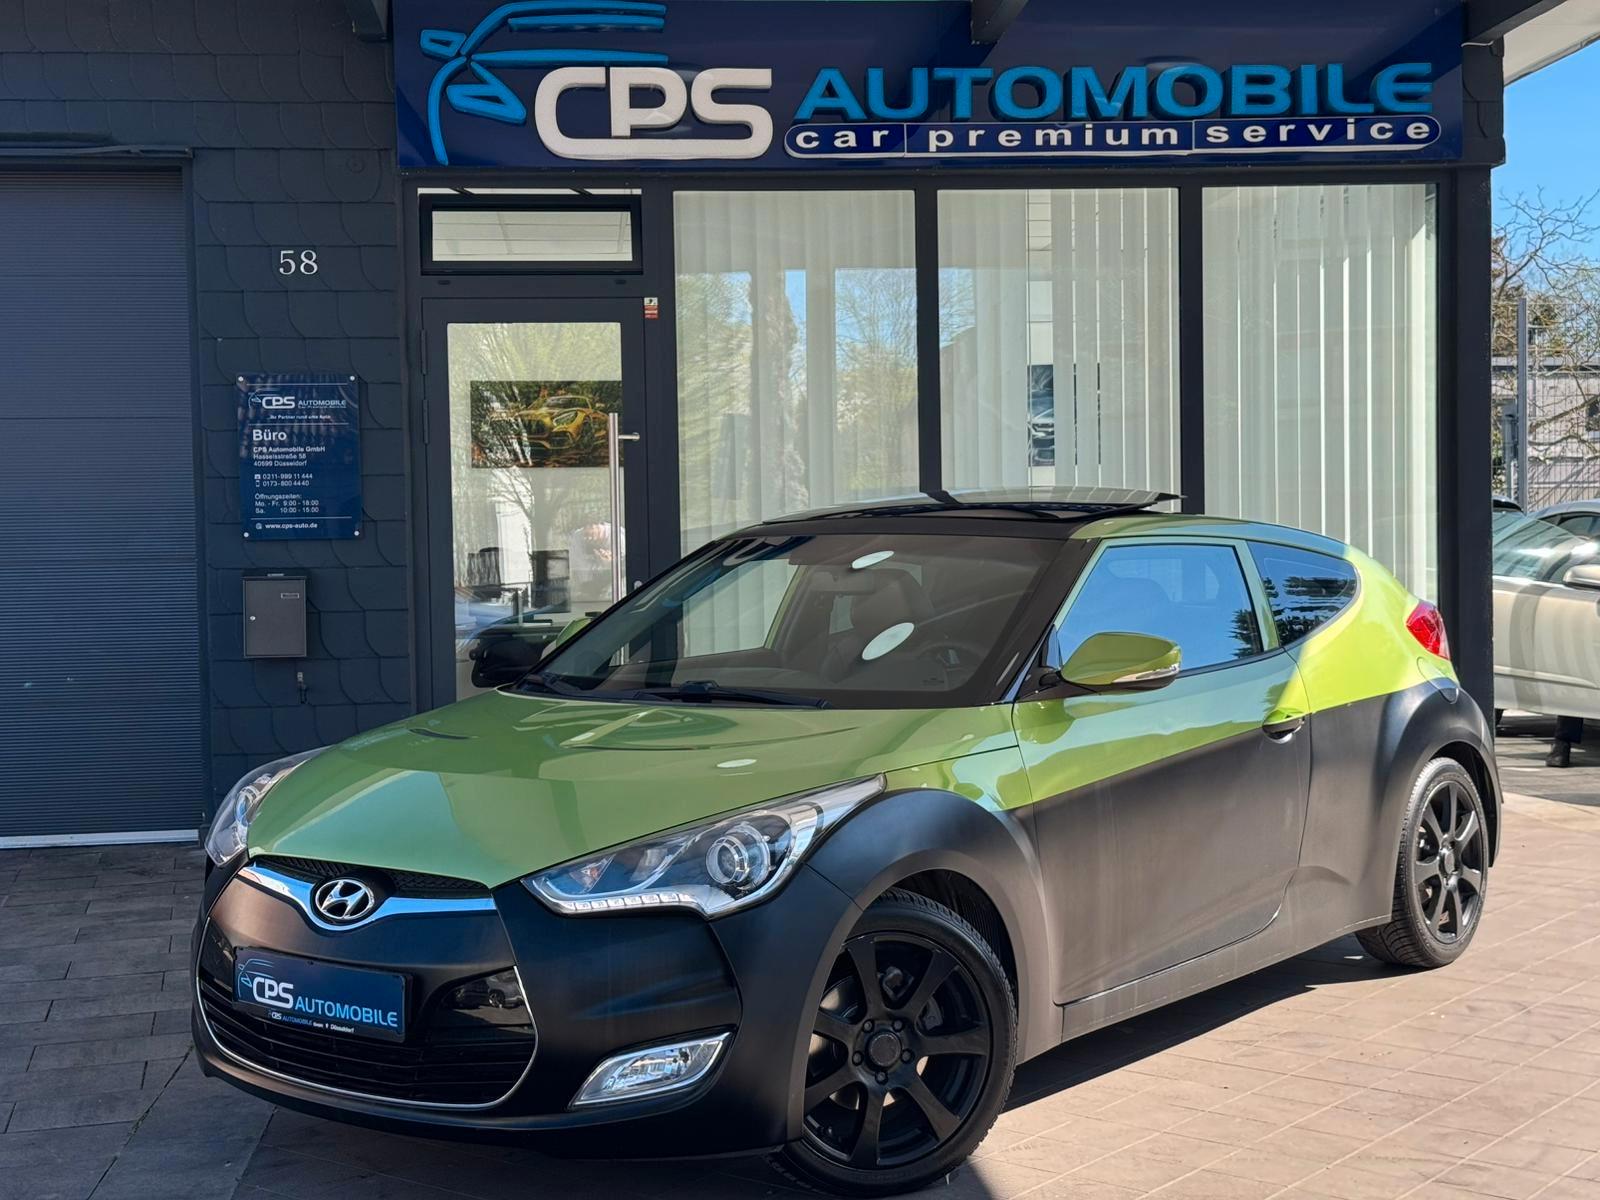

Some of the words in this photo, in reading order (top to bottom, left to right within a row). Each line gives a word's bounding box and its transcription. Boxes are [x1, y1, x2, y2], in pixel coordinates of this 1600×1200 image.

[535, 66, 774, 160] CPS
[794, 61, 1434, 121] AUTOMOBILE
[795, 127, 889, 149] car
[929, 121, 1180, 153] premium
[1205, 118, 1431, 143] service
[279, 249, 319, 275] 58
[262, 396, 295, 409] CPS
[252, 429, 287, 441] Büro
[265, 522, 318, 530] www.cps-auto.de
[252, 976, 294, 1009] CPS
[294, 996, 399, 1028] AUTOMOBILE
[271, 1011, 282, 1020] CPS
[282, 1015, 313, 1026] AUTOMOBILE
